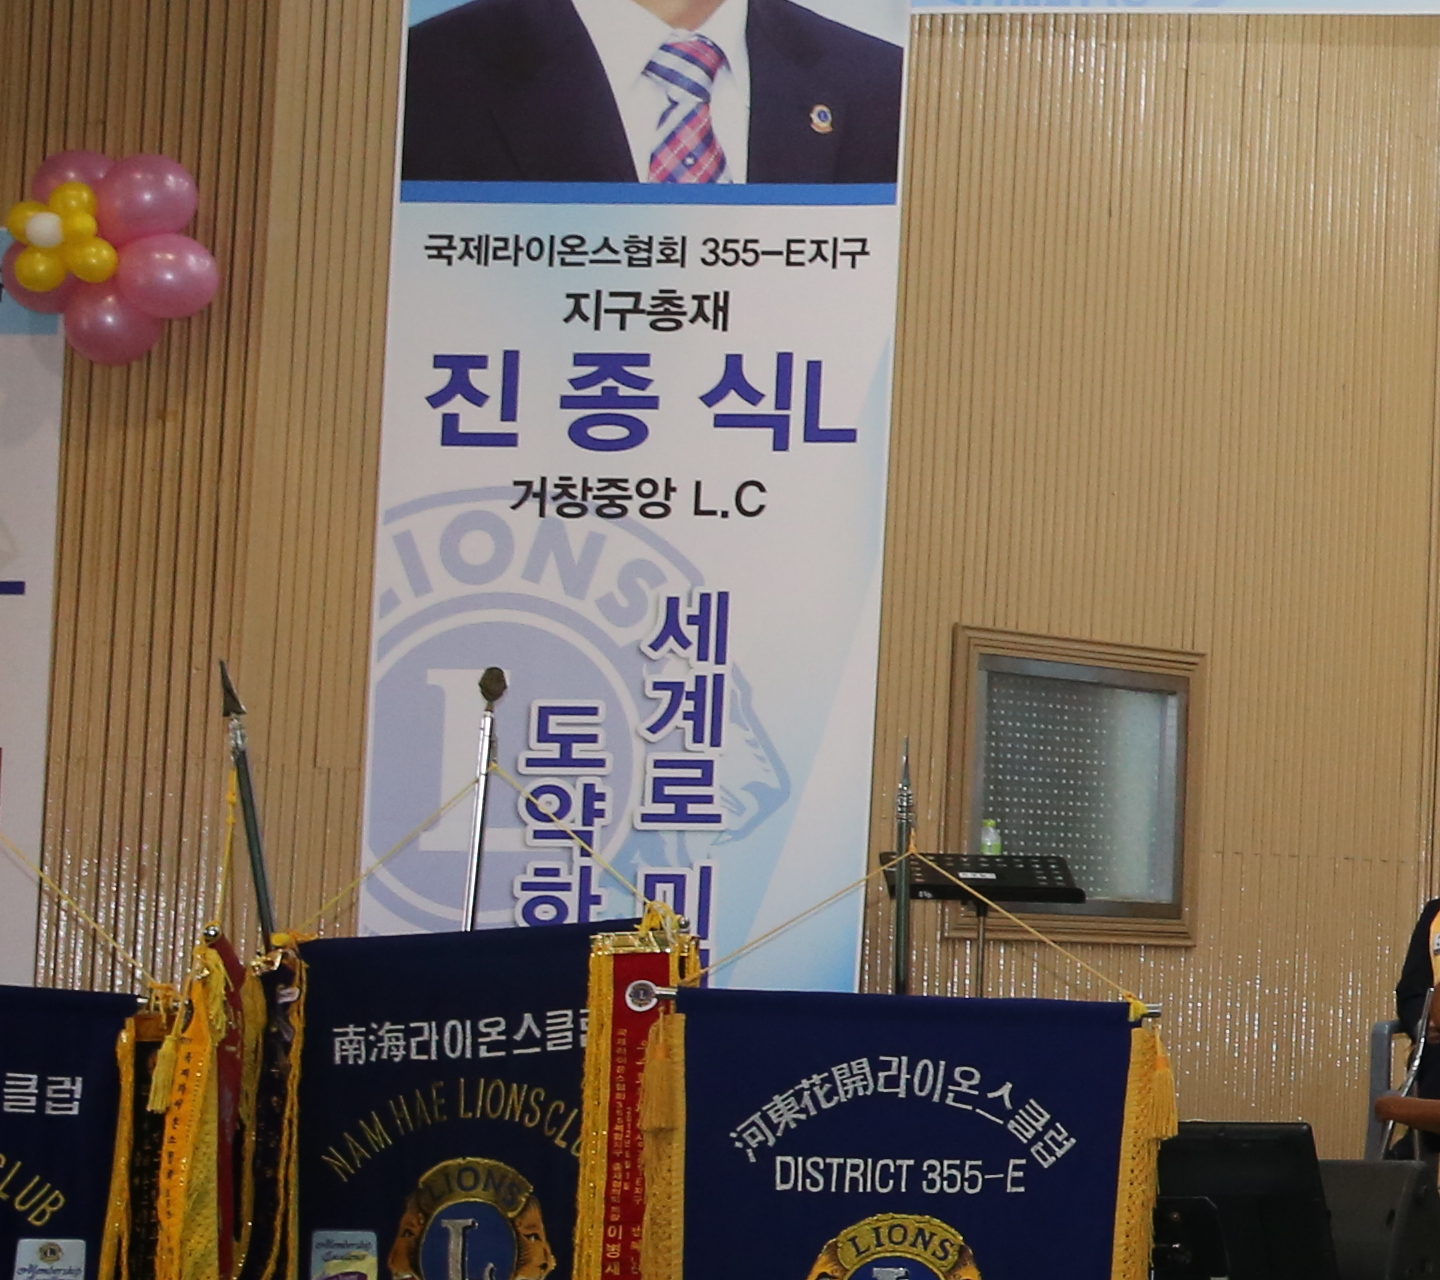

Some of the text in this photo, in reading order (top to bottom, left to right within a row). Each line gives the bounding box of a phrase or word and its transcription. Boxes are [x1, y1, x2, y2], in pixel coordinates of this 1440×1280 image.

[424, 233, 870, 270] 국제라이온스협회 355-E지구
[562, 289, 730, 332] 지구총재
[509, 475, 768, 520] 거창중앙 L.C
[640, 591, 730, 825] 세계로
[729, 1055, 1078, 1169] 河東花開라이온스클럽
[774, 1156, 1027, 1196] DISTRICT 355-E
[846, 1222, 955, 1263] LIONS
